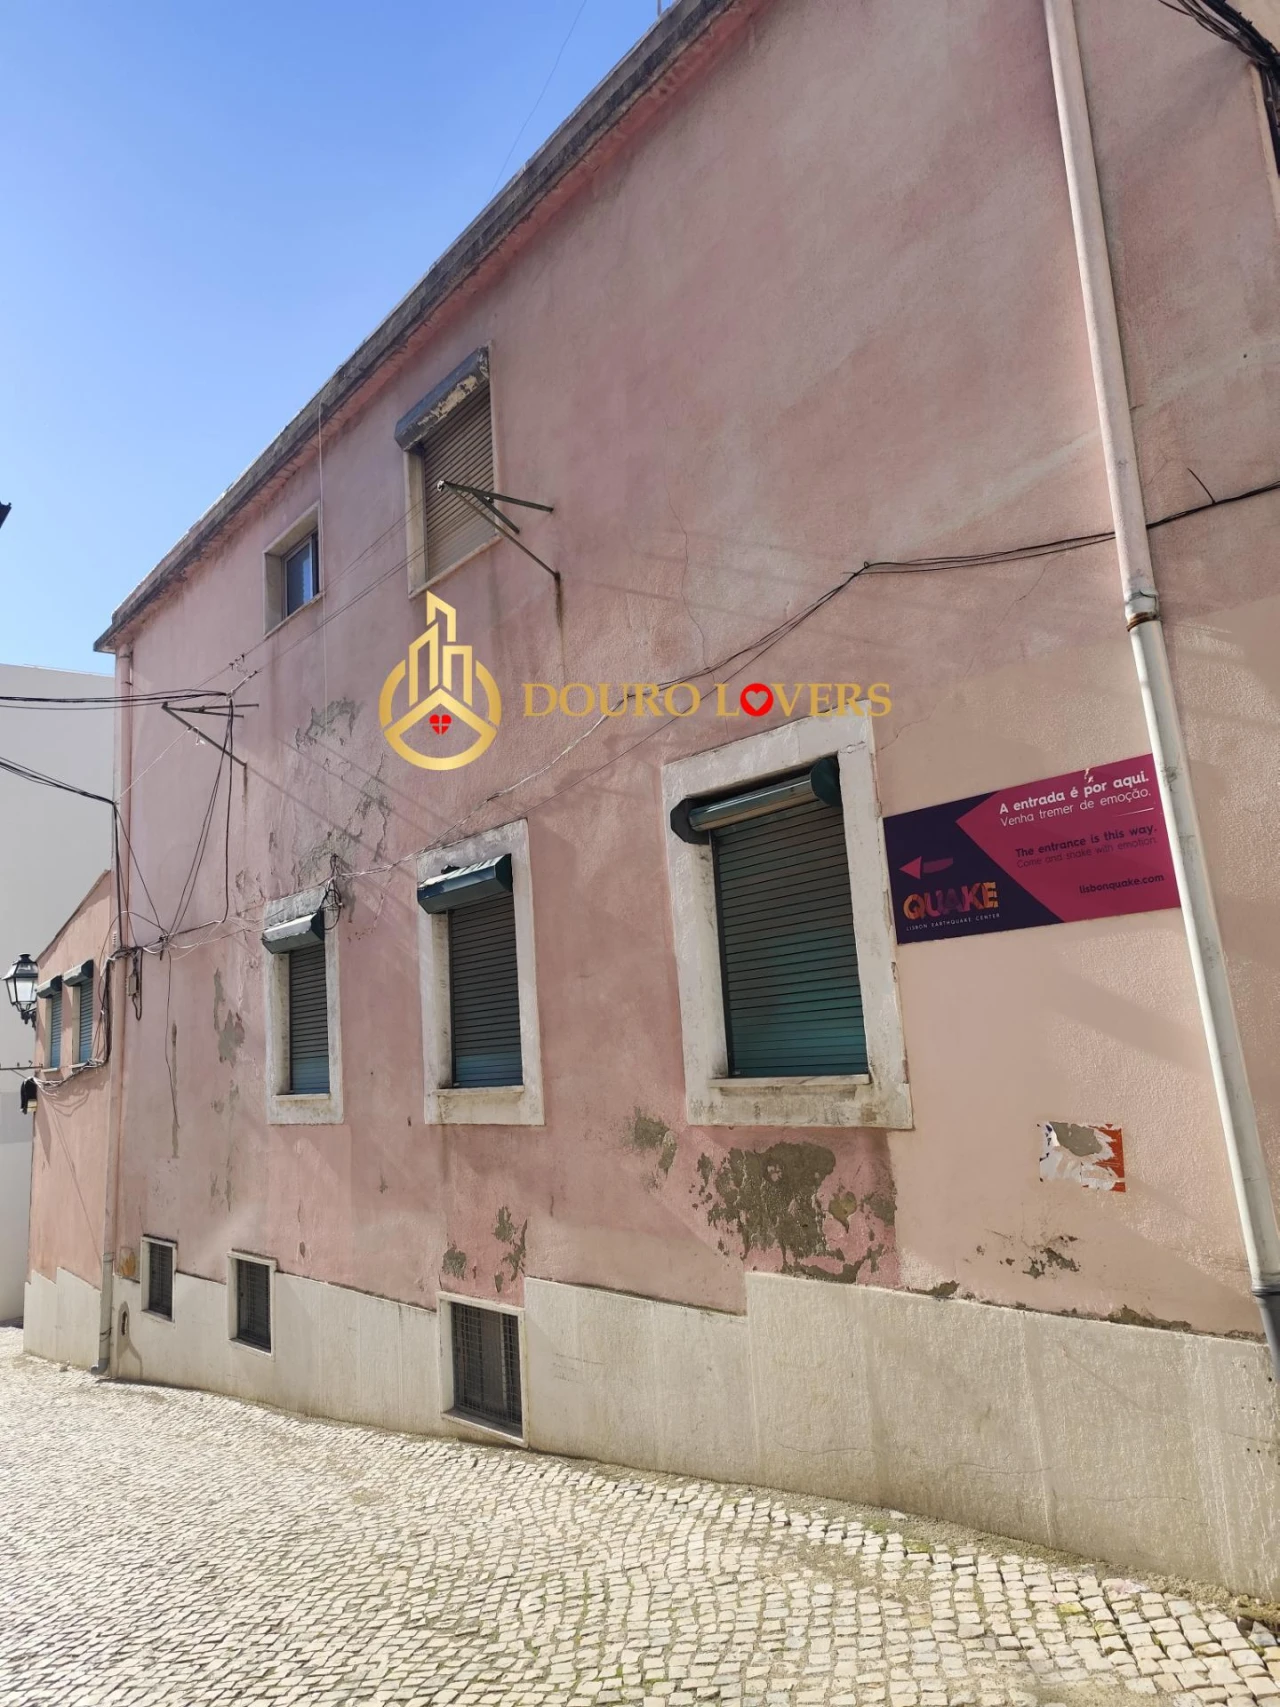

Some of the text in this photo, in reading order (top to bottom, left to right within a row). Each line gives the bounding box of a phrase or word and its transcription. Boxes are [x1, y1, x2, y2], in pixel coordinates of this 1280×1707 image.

[1000, 771, 1149, 814] A entrada é por aqui.
[1001, 788, 1150, 827] Venha tremer de emoção.
[1016, 824, 1157, 857] The entrance is this way.
[1016, 857, 1041, 868] Come
[1045, 851, 1062, 864] and
[1066, 846, 1092, 861] shake
[1095, 842, 1113, 854] with
[1079, 873, 1164, 894] lisbonquake.com
[903, 882, 999, 920] QUAKE
[906, 913, 1000, 931] LISBON EARTHQUAKE CENTER
